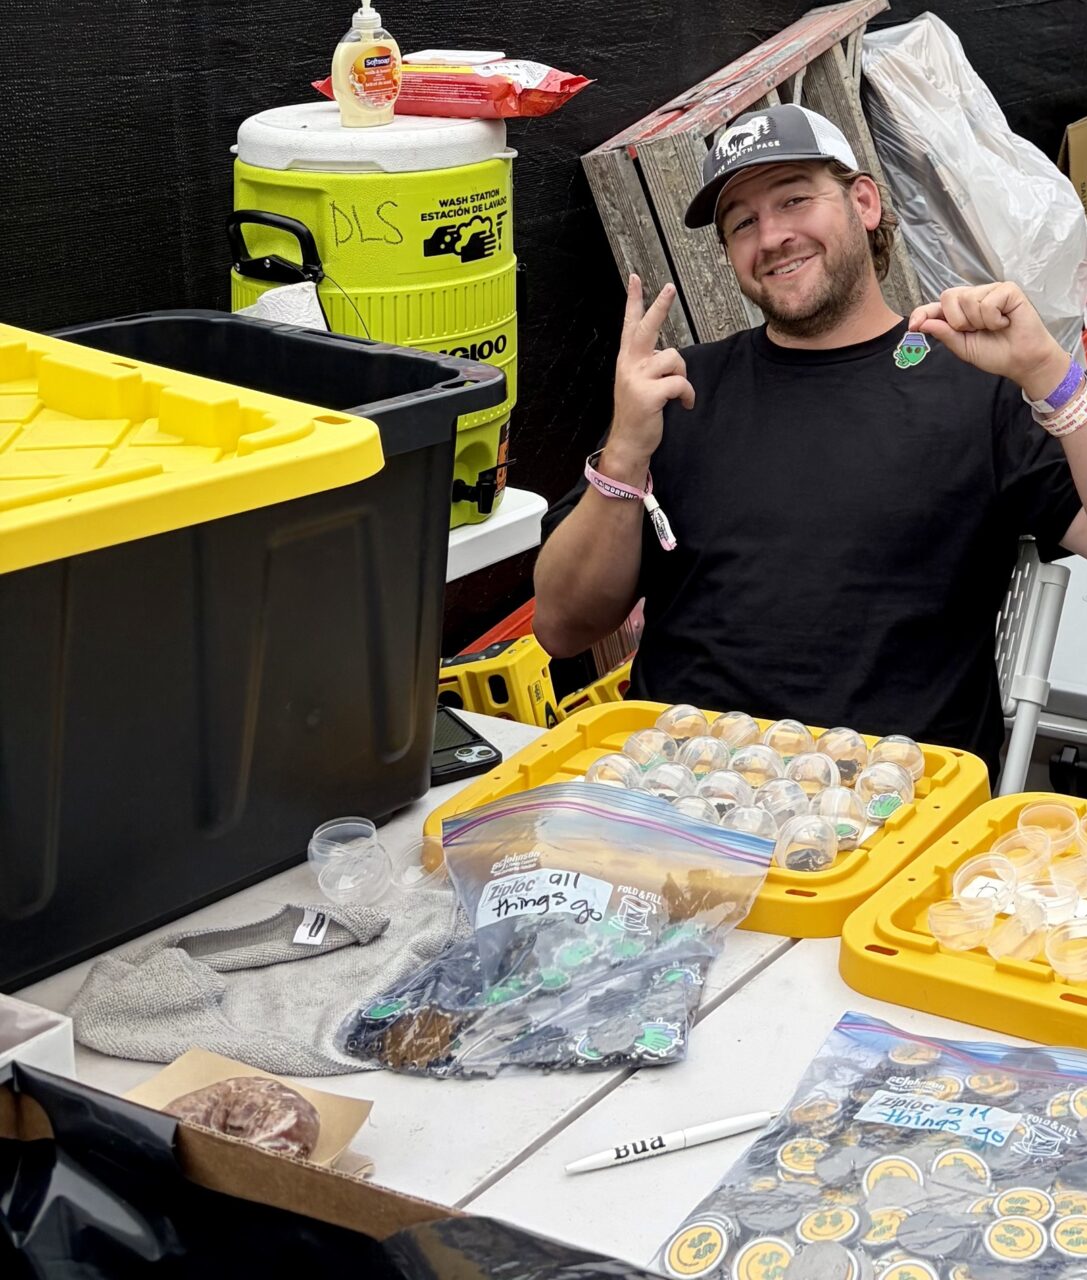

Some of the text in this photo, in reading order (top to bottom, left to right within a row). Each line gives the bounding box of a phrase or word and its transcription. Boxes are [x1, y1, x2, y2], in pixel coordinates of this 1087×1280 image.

[365, 57, 390, 66] Softsoap
[727, 147, 753, 166] NORTH
[439, 188, 500, 208] WASH STATION
[421, 196, 507, 222] ESTACIÓN DE LAVADO
[329, 200, 403, 247] DLS
[440, 335, 506, 361] GLOO
[549, 872, 580, 888] all
[489, 879, 537, 901] Ziploc
[617, 885, 639, 896] FOLD
[646, 891, 662, 904] FILL
[492, 891, 602, 925] things go
[879, 1096, 936, 1113] Ziploc
[946, 1106, 993, 1121] all
[877, 1108, 1005, 1149] things go
[1059, 1125, 1078, 1138] FILL
